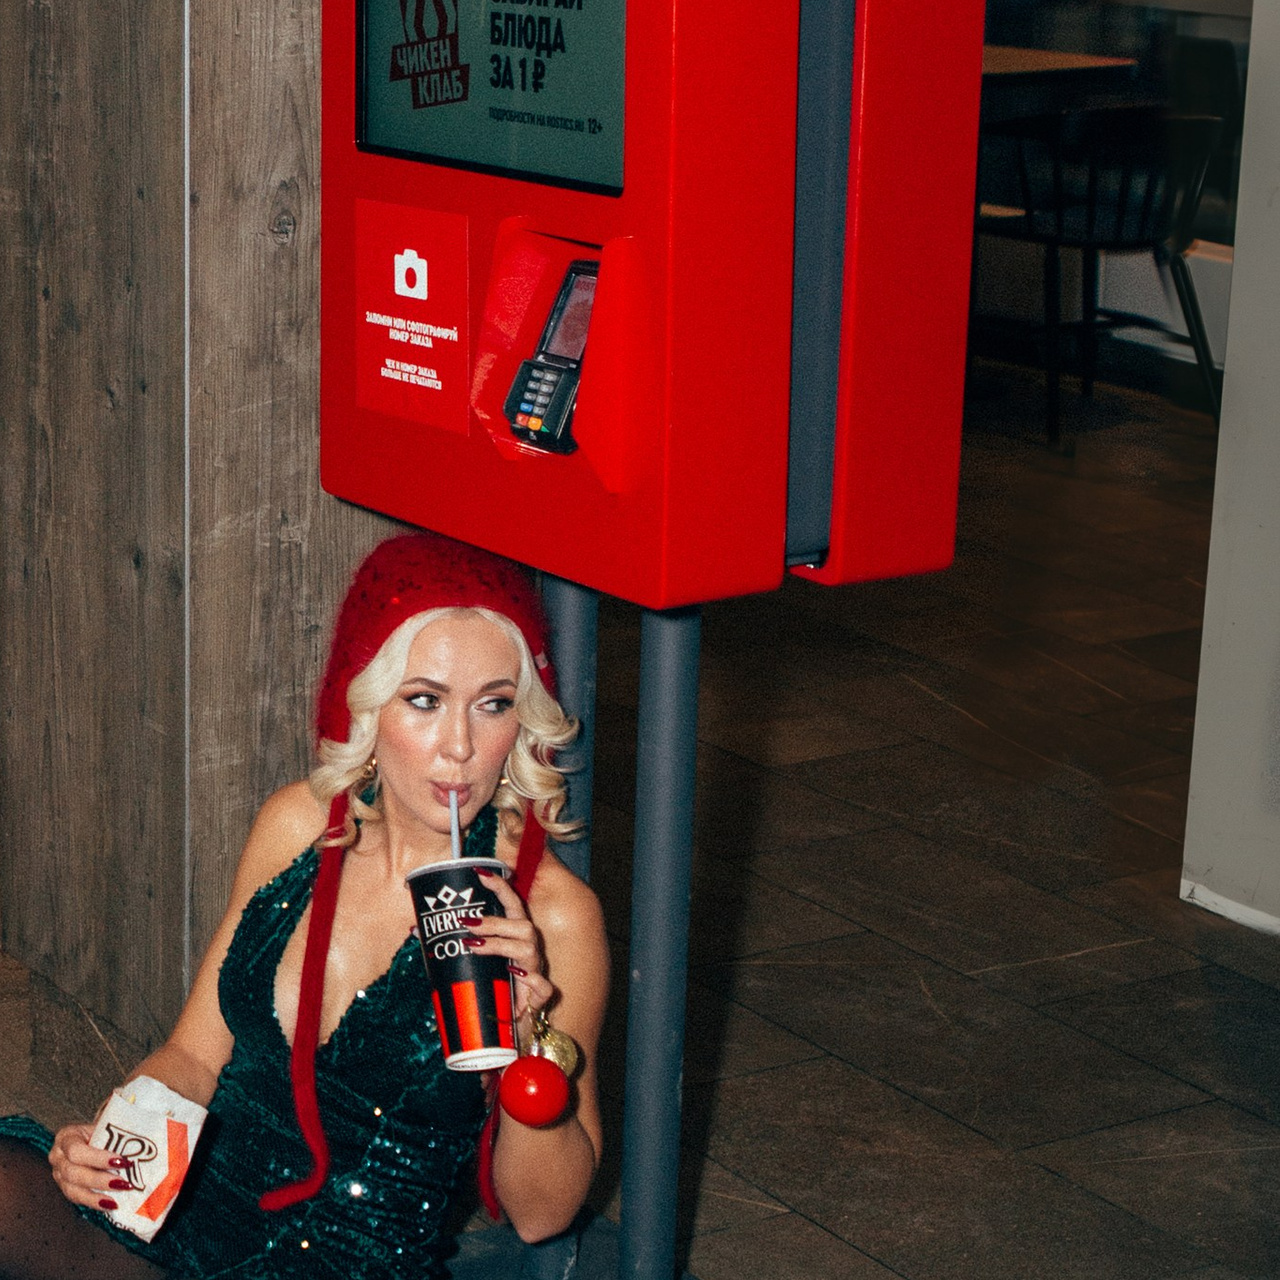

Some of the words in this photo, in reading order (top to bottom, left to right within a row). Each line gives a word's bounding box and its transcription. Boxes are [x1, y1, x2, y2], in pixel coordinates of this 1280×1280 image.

[490, 12, 566, 58] БЛЮДА
[396, 38, 452, 75] ЧИКЕН
[489, 54, 514, 90] ЗА
[419, 69, 464, 105] КЛАБ
[587, 118, 603, 134] 12+
[434, 938, 474, 960] COL
